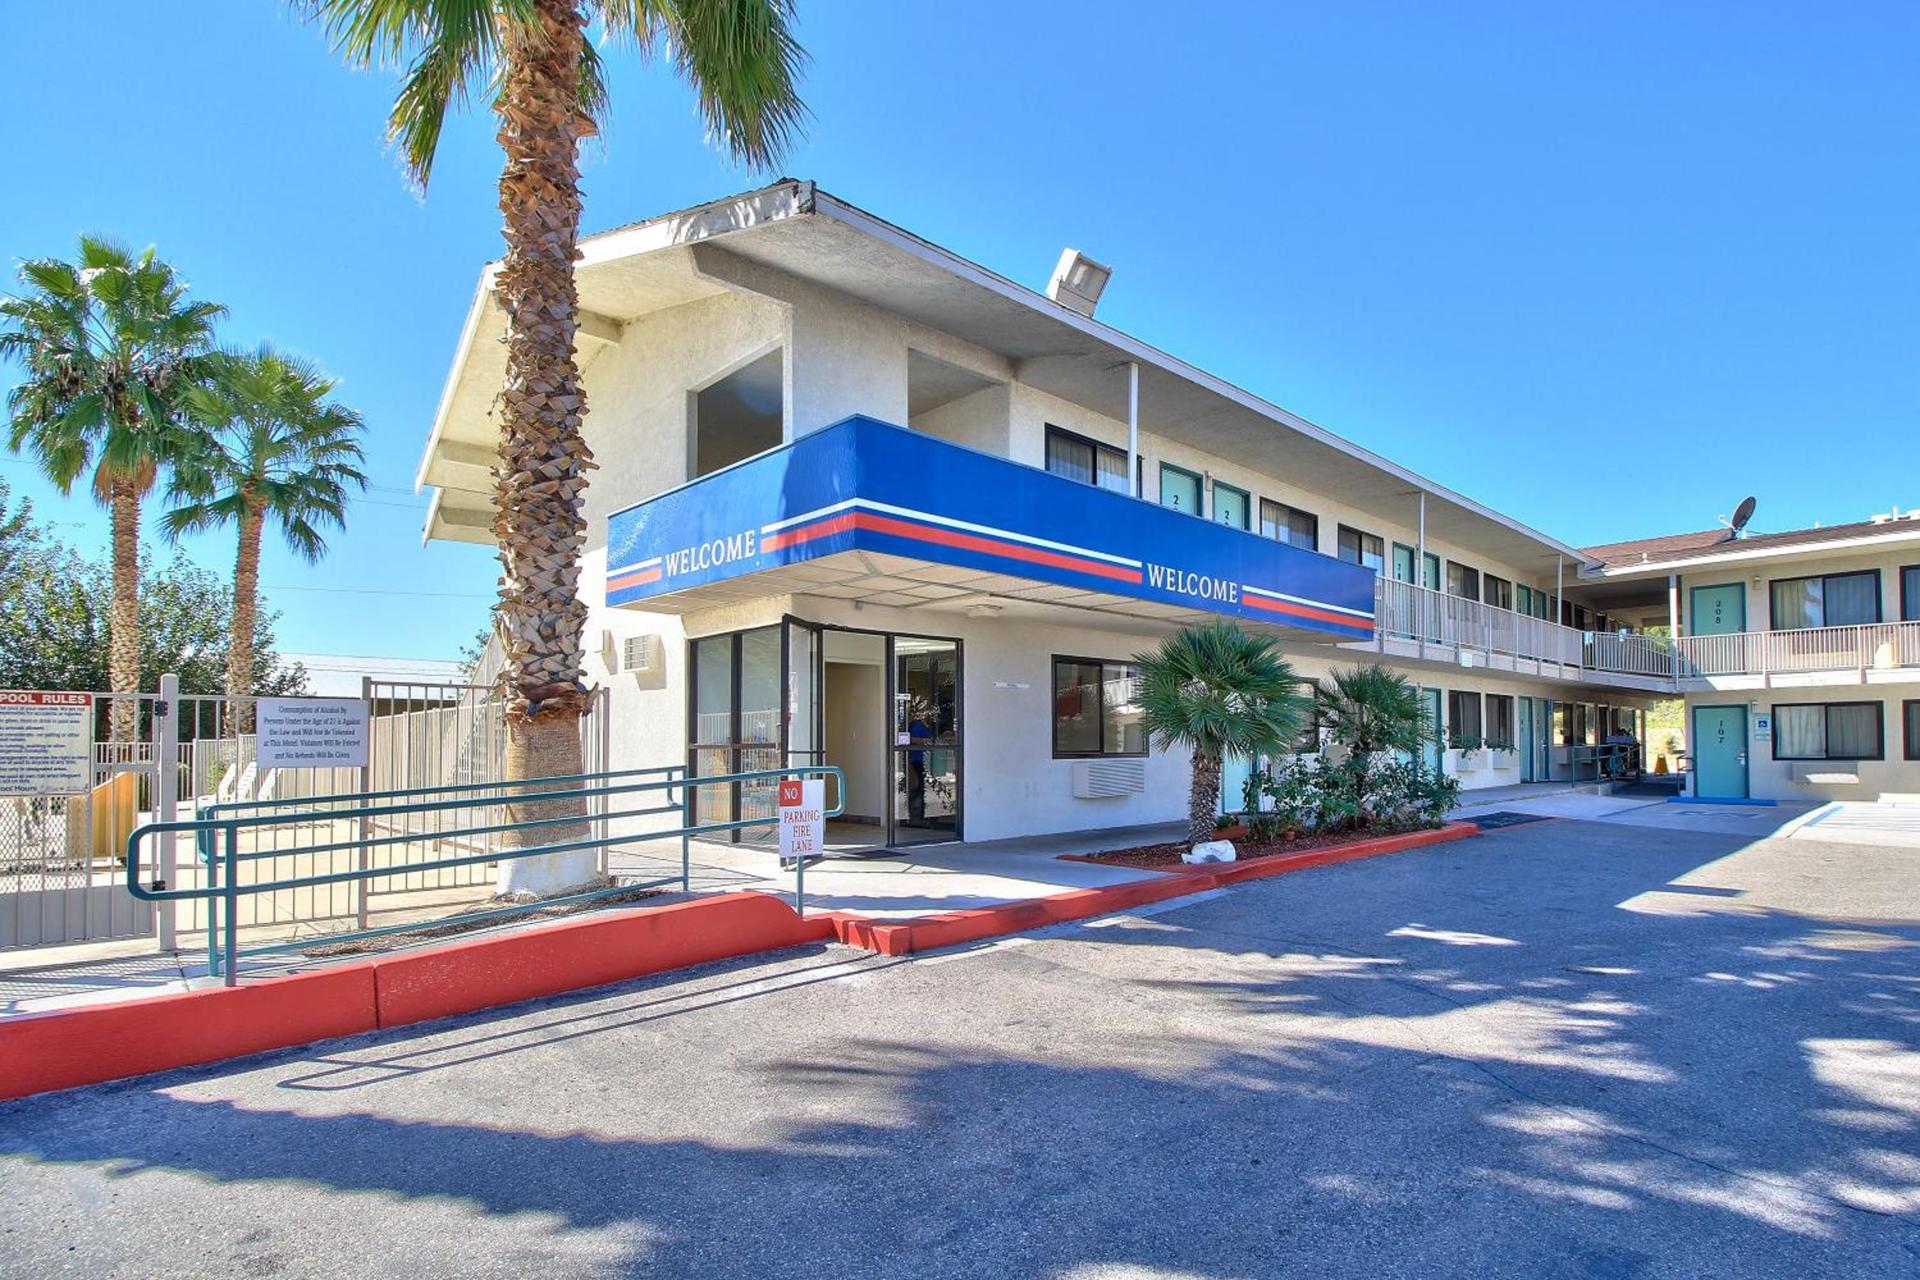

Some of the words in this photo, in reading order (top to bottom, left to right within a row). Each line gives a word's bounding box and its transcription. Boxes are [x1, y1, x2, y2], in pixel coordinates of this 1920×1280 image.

[665, 529, 756, 577] WELCOME
[1147, 562, 1239, 603] WELCOME
[0, 693, 36, 703] POOL
[42, 694, 86, 704] RULES
[285, 717, 301, 725] Under
[303, 717, 312, 725] the
[784, 787, 798, 800] NO
[783, 809, 820, 823] PARKING
[793, 825, 811, 838] FIRE
[791, 840, 812, 853] LANE
